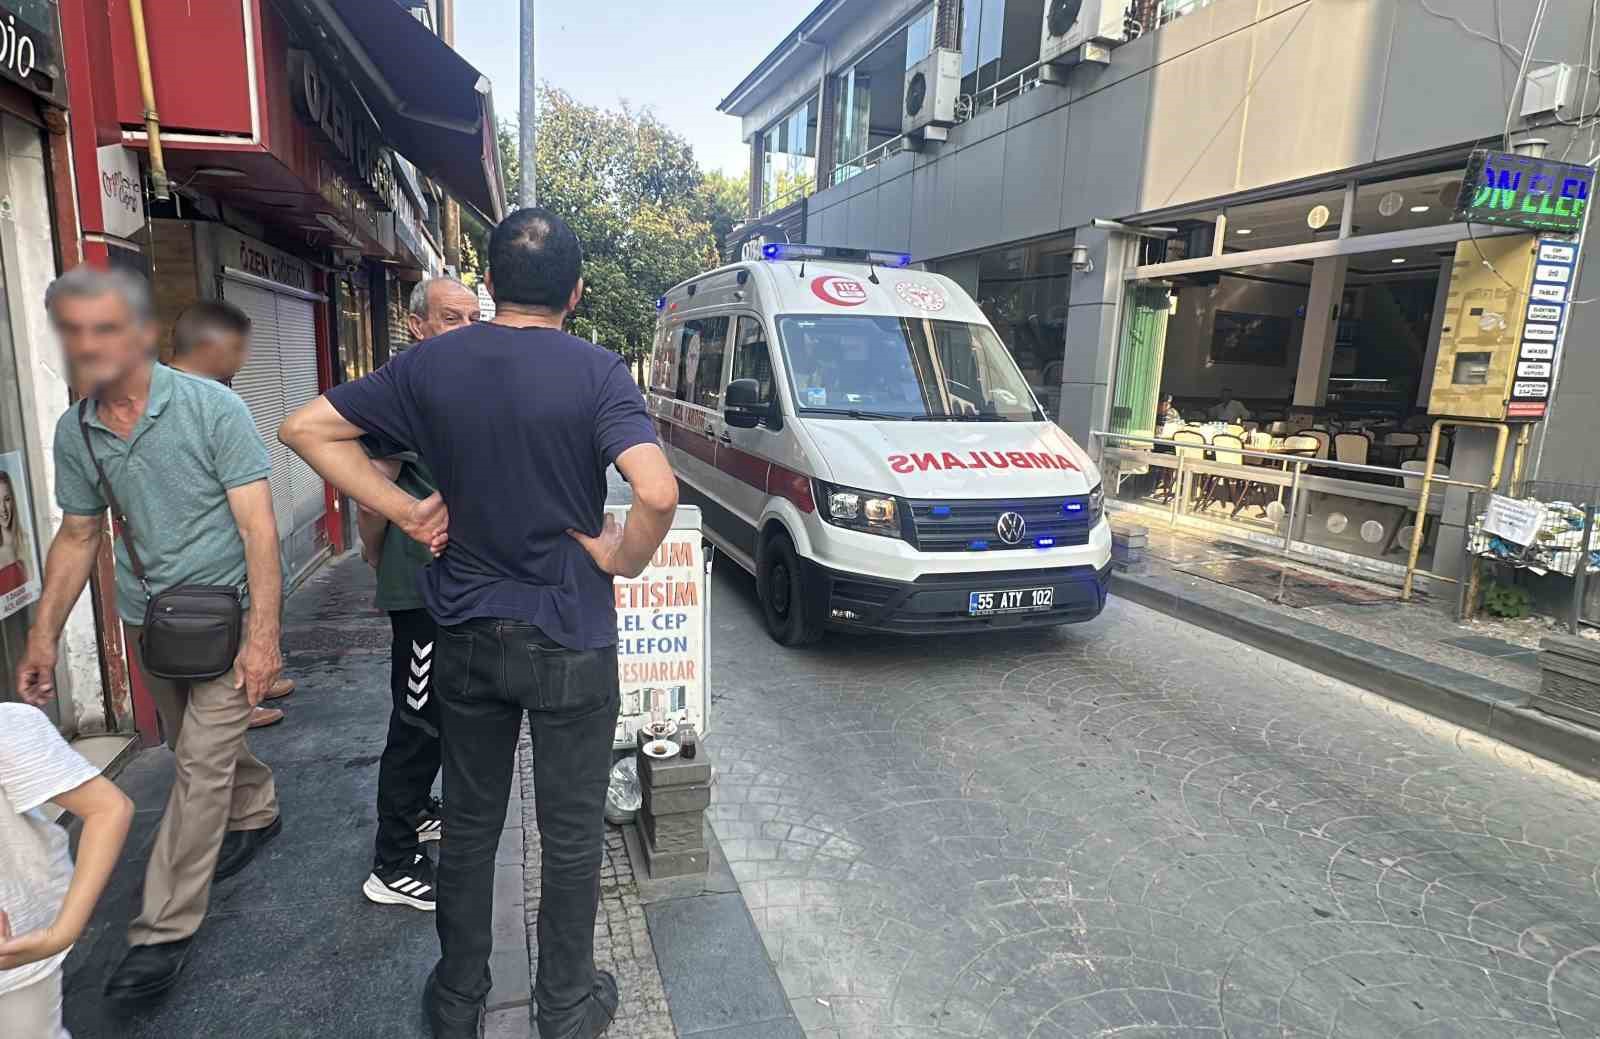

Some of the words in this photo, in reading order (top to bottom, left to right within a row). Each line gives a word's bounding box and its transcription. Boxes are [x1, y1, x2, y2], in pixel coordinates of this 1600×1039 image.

[837, 282, 860, 292] 112
[978, 593, 994, 610] 55
[1000, 591, 1023, 608] ATY
[1032, 590, 1052, 606] 102
[651, 613, 688, 631] CEP
